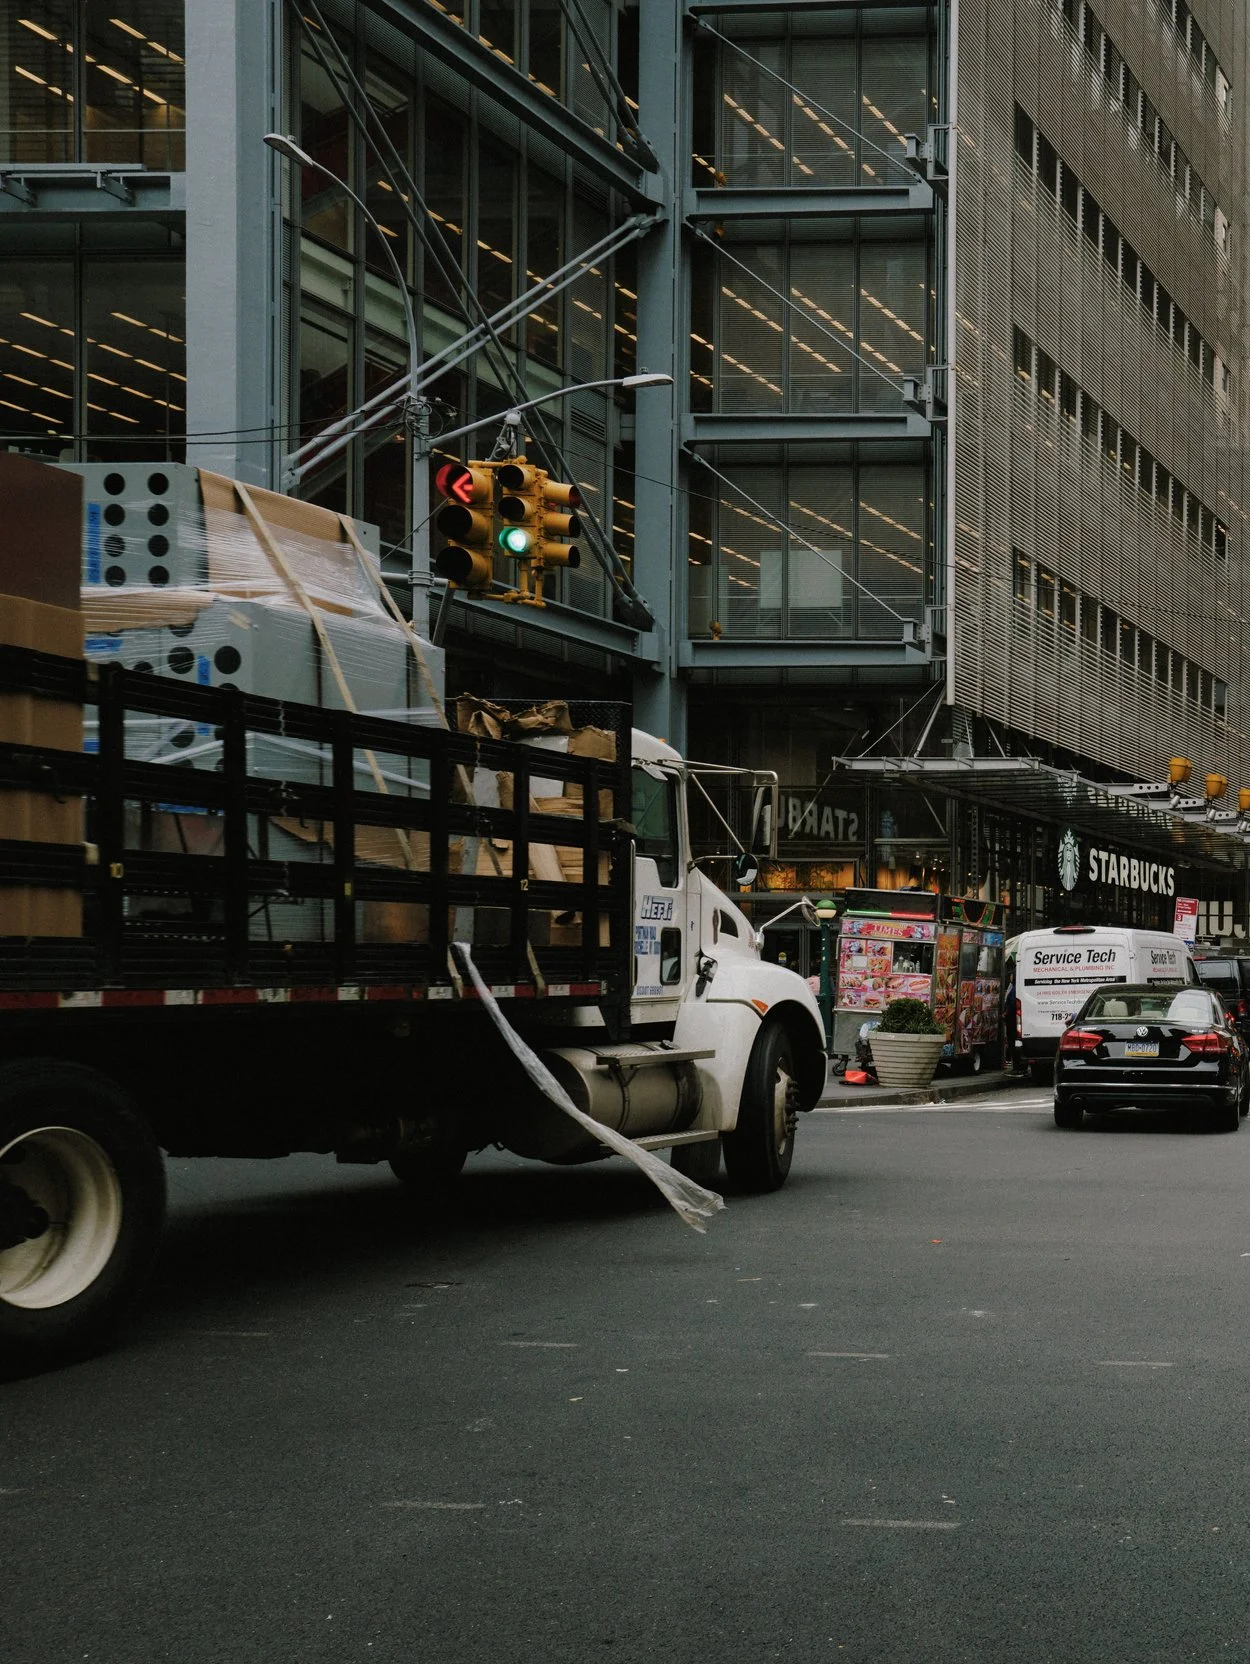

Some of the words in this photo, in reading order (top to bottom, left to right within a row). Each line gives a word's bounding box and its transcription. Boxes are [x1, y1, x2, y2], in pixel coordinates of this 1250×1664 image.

[1088, 848, 1175, 897] STARBUCKS
[872, 923, 904, 937] TIMES
[1033, 950, 1082, 965] Service
[1087, 948, 1116, 963] Tech
[1150, 950, 1167, 964] Service
